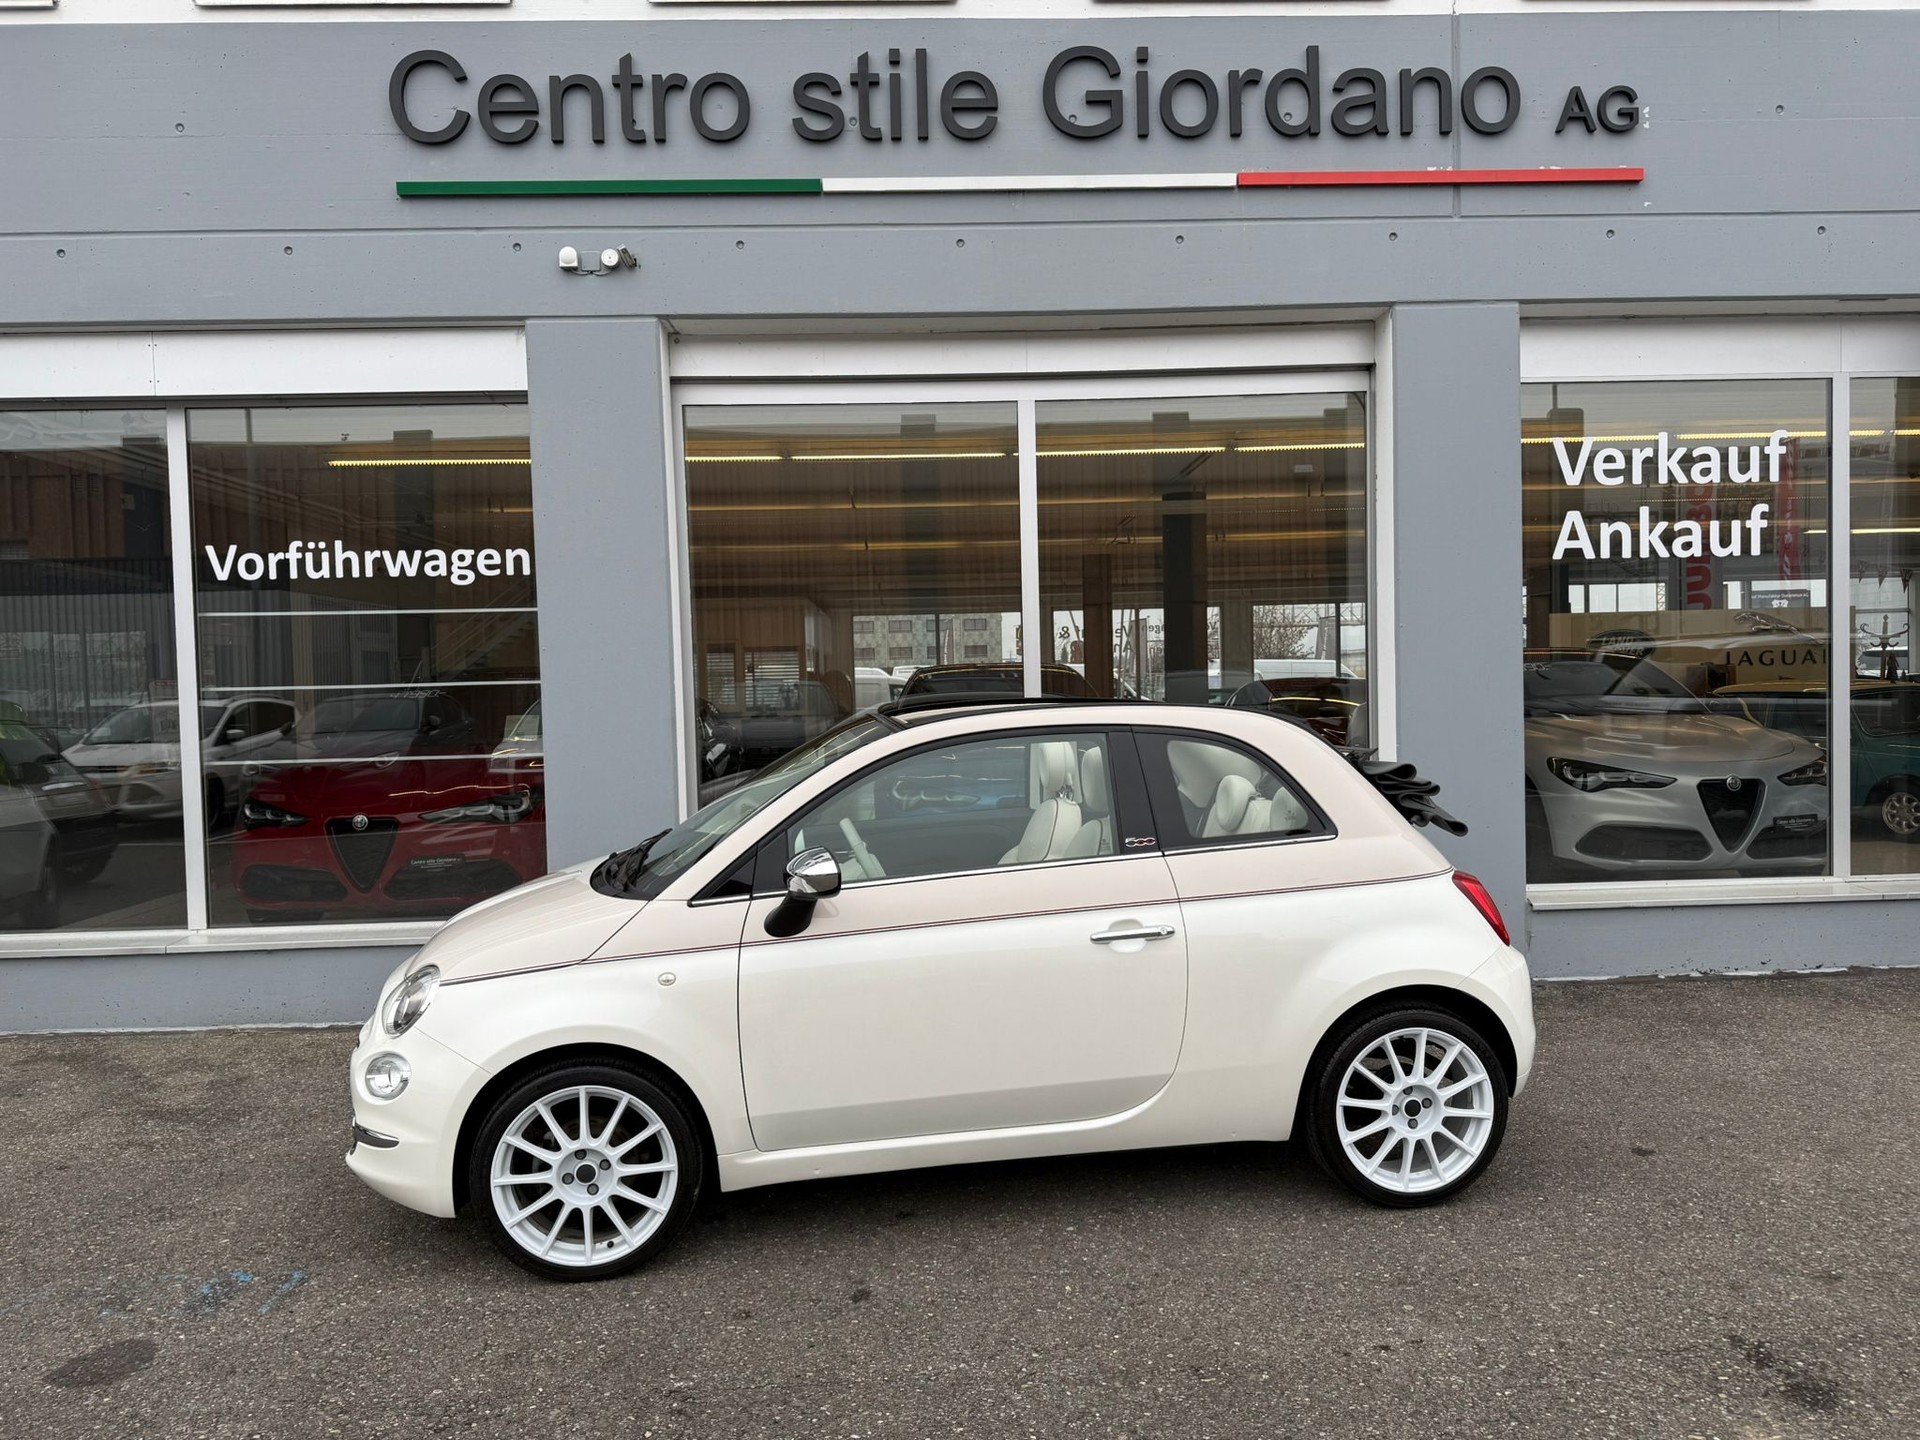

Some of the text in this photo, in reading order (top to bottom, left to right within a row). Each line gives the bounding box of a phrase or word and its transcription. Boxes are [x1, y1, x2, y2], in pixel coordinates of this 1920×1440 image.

[389, 44, 1640, 145] Centro stile Giordano AG
[1553, 430, 1788, 486] Verkauf
[1552, 504, 1770, 560] Ankauf
[205, 540, 531, 585] Vorführwagen
[1125, 837, 1156, 848] 500
